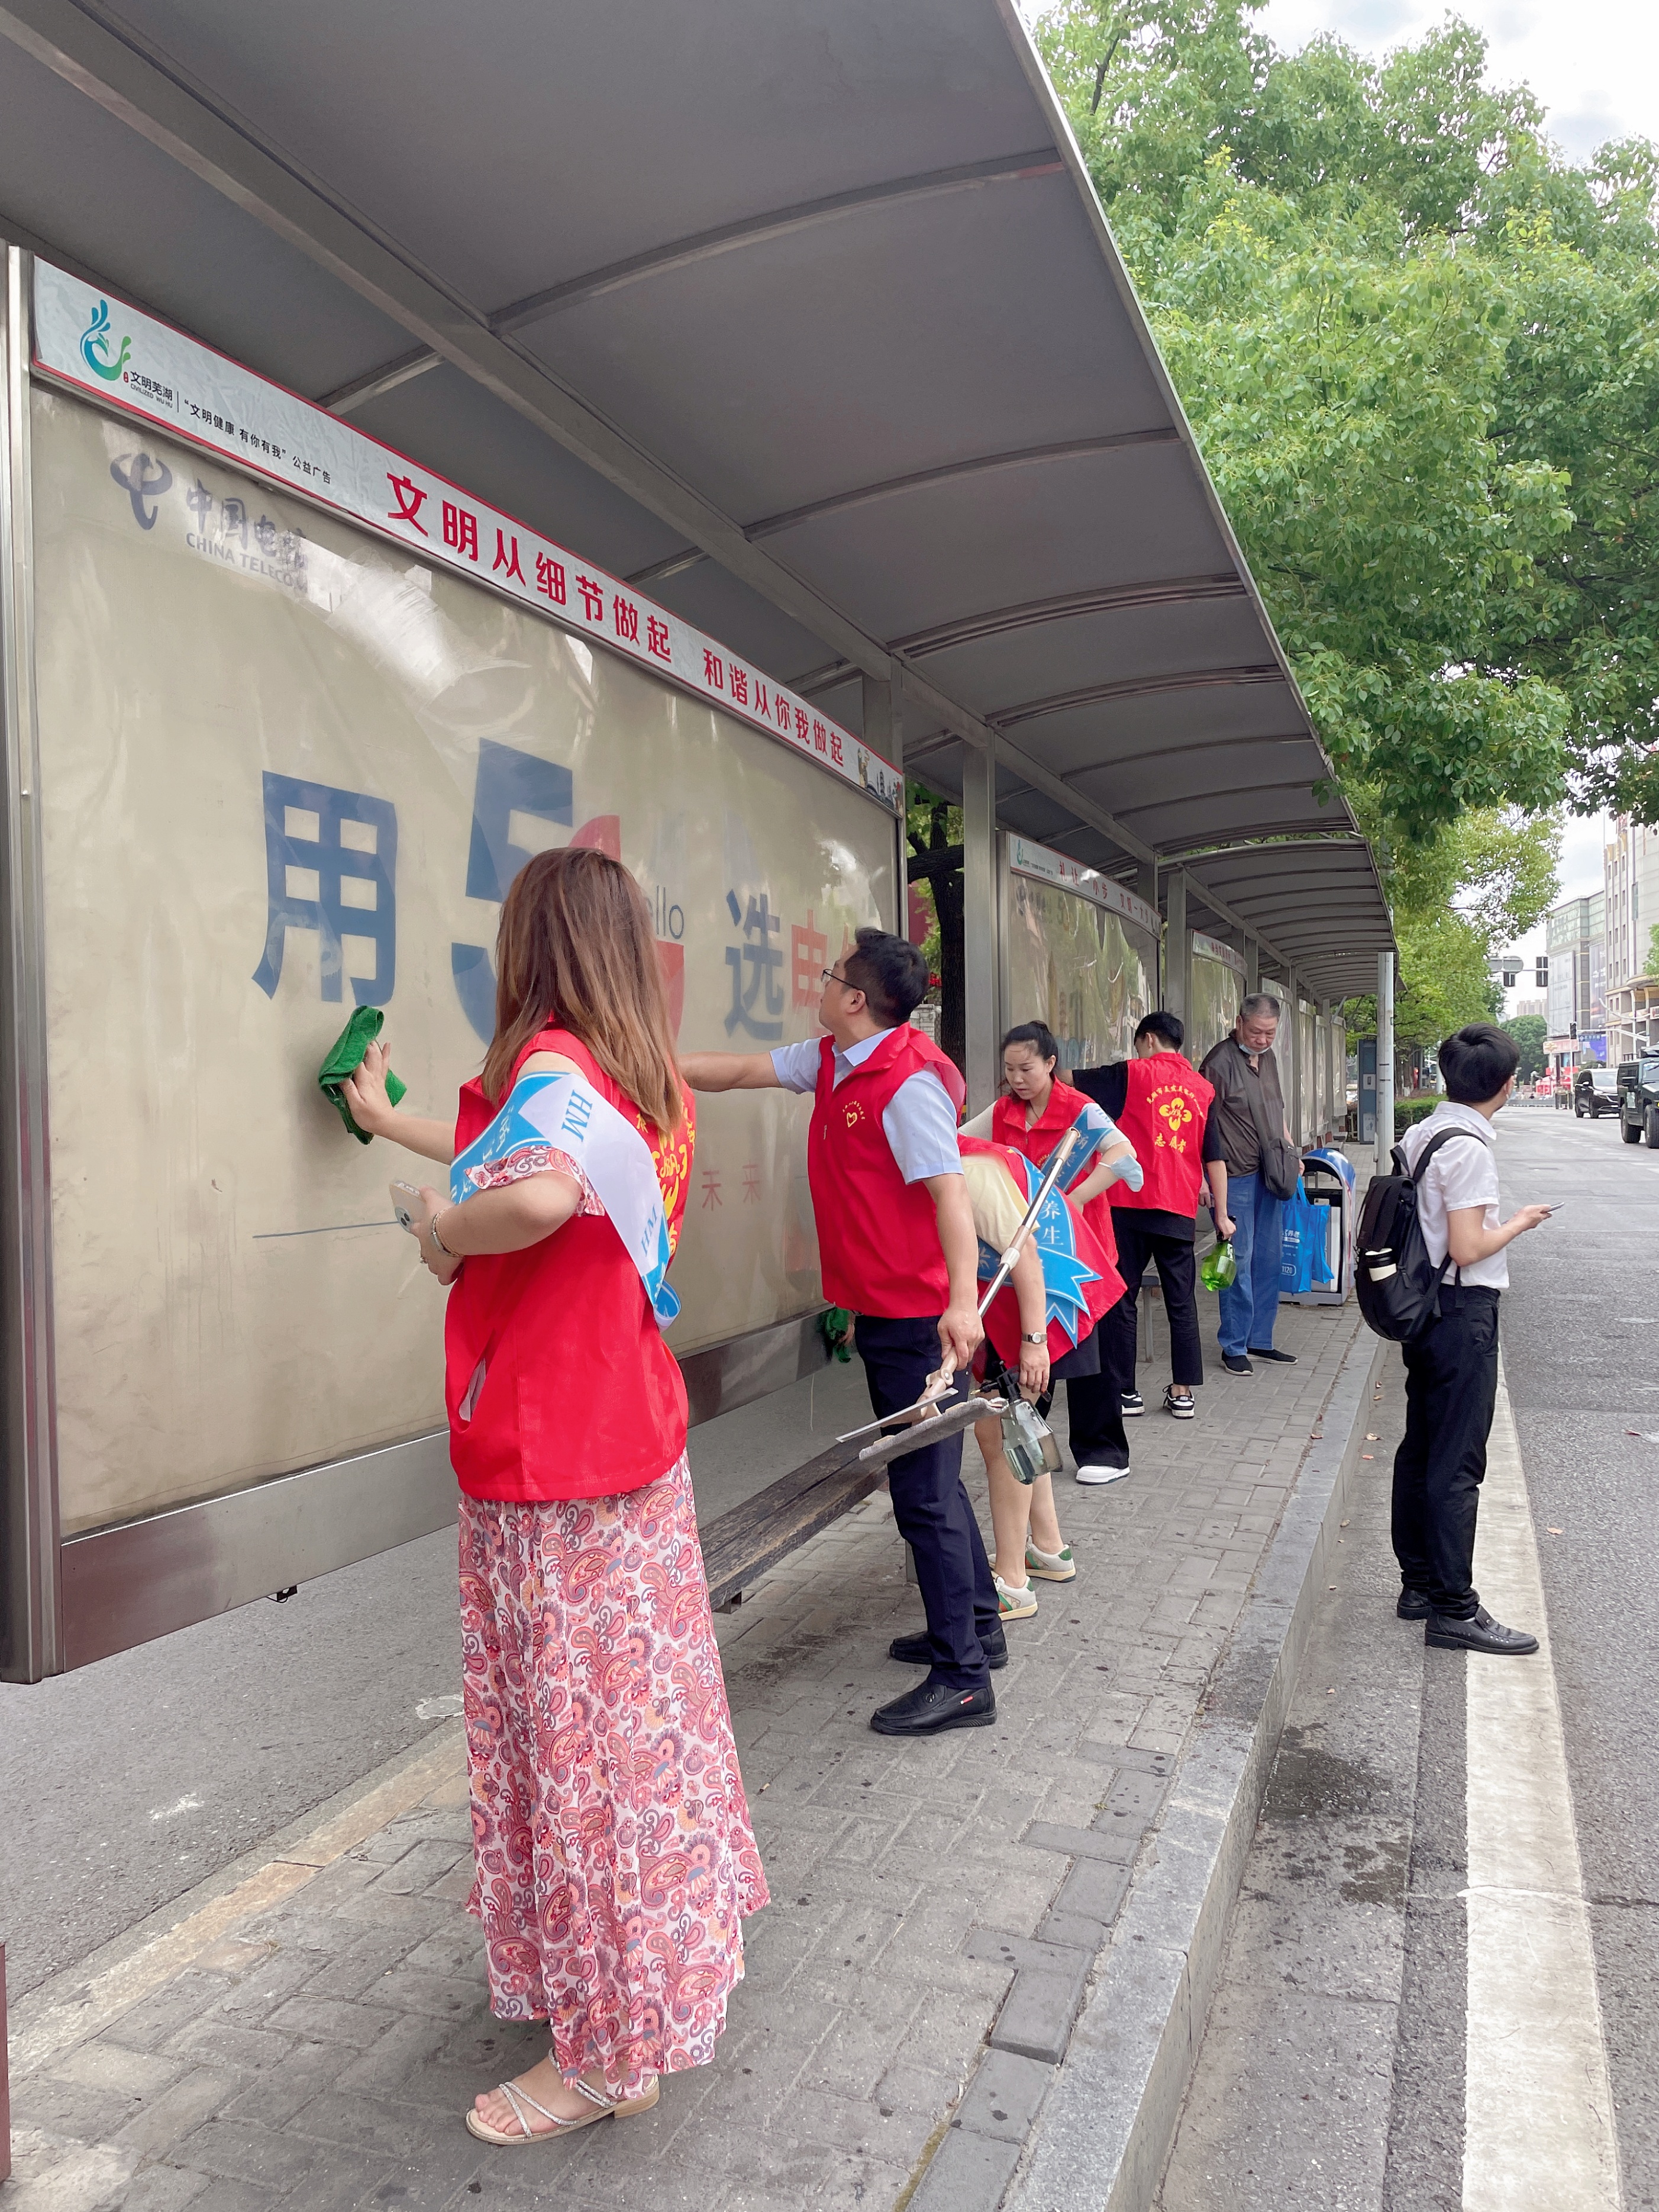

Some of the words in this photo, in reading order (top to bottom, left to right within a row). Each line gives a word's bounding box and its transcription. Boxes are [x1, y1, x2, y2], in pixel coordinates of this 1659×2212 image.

[130, 370, 173, 401] 文明芜湖
[292, 455, 331, 485] 公益广告
[186, 532, 235, 565] CHINA
[386, 472, 672, 663] 文明从细节做起
[703, 647, 844, 768] 和谐从你我做起
[1038, 1178, 1064, 1246] 养生
